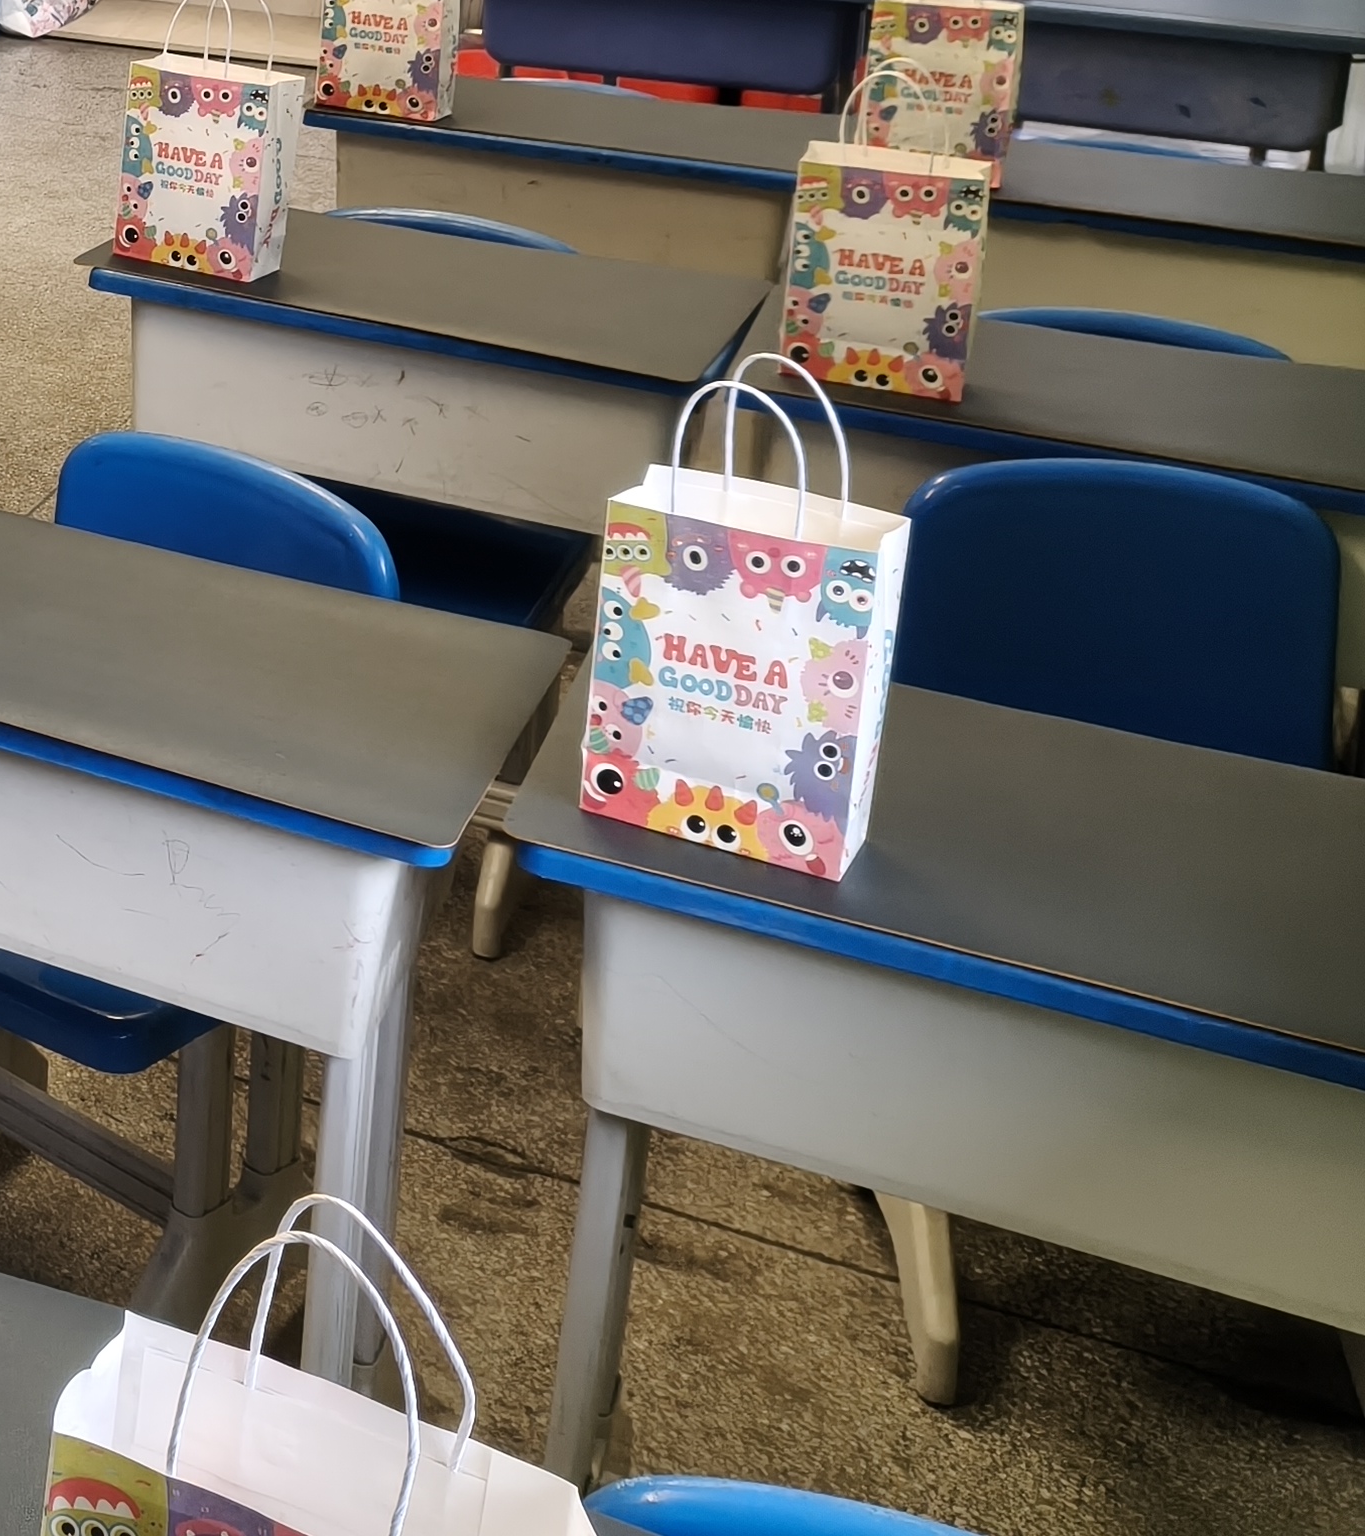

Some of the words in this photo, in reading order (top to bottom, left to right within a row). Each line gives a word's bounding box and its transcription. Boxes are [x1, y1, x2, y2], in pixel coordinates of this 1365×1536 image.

[351, 11, 394, 30] HAVE
[397, 17, 408, 31] A
[959, 75, 972, 88] A
[158, 142, 206, 166] HAVE
[210, 153, 223, 169] A
[838, 248, 903, 275] HAVE
[908, 258, 926, 277] A
[663, 634, 757, 681] HAVE
[764, 660, 788, 689] A
[668, 696, 771, 734] 祝你今天愉快
